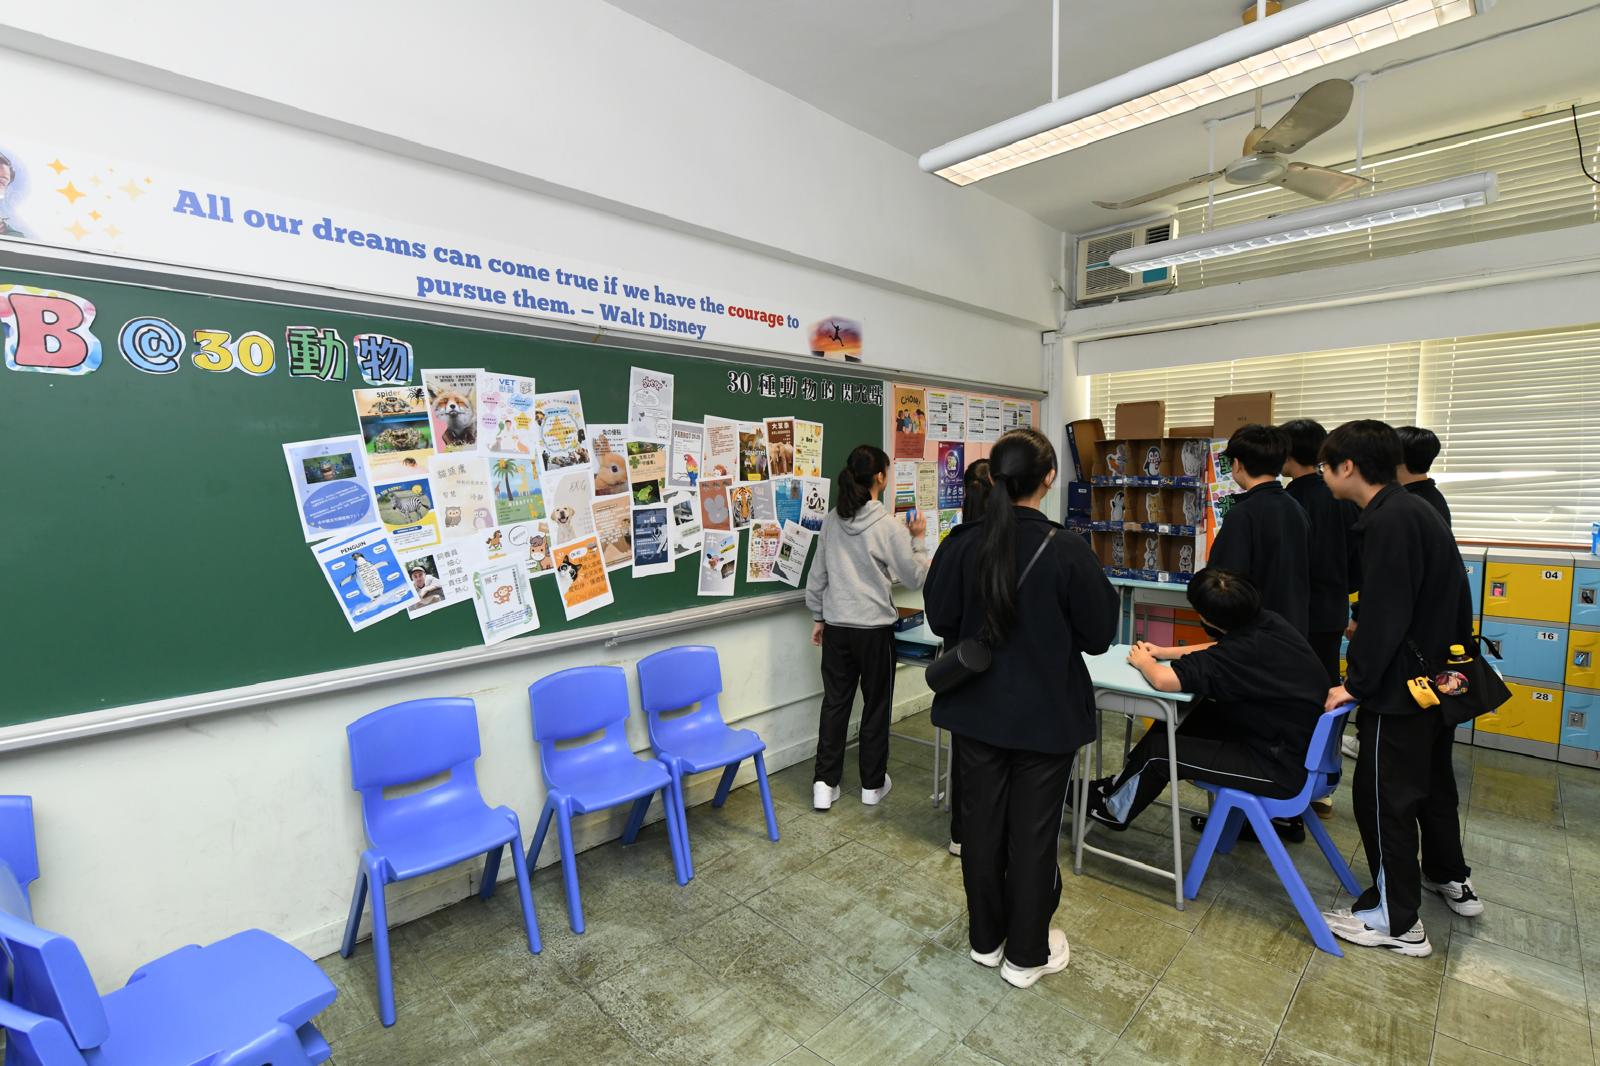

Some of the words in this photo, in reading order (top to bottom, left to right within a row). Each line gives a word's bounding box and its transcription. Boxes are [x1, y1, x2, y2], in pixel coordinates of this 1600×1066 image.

[173, 190, 234, 223] All
[243, 209, 304, 235] our
[312, 217, 427, 260] dreams
[433, 246, 482, 270] can
[488, 258, 551, 282] come
[556, 268, 599, 292] true
[604, 276, 619, 295] if
[623, 284, 650, 302] we
[655, 286, 696, 311] have
[700, 296, 725, 315] the
[728, 305, 785, 329] courage
[787, 314, 800, 330] to
[416, 276, 507, 305] pursue
[513, 288, 576, 316] them.
[600, 303, 646, 328] Walt
[649, 311, 707, 341] Disney
[8, 293, 89, 369] B
[498, 379, 516, 387] VET
[727, 371, 752, 394] 30
[376, 390, 401, 401] spider
[340, 541, 367, 554] PENGUIN
[1545, 571, 1559, 580] 04
[1541, 632, 1554, 641] 16
[1535, 692, 1549, 701] 28
